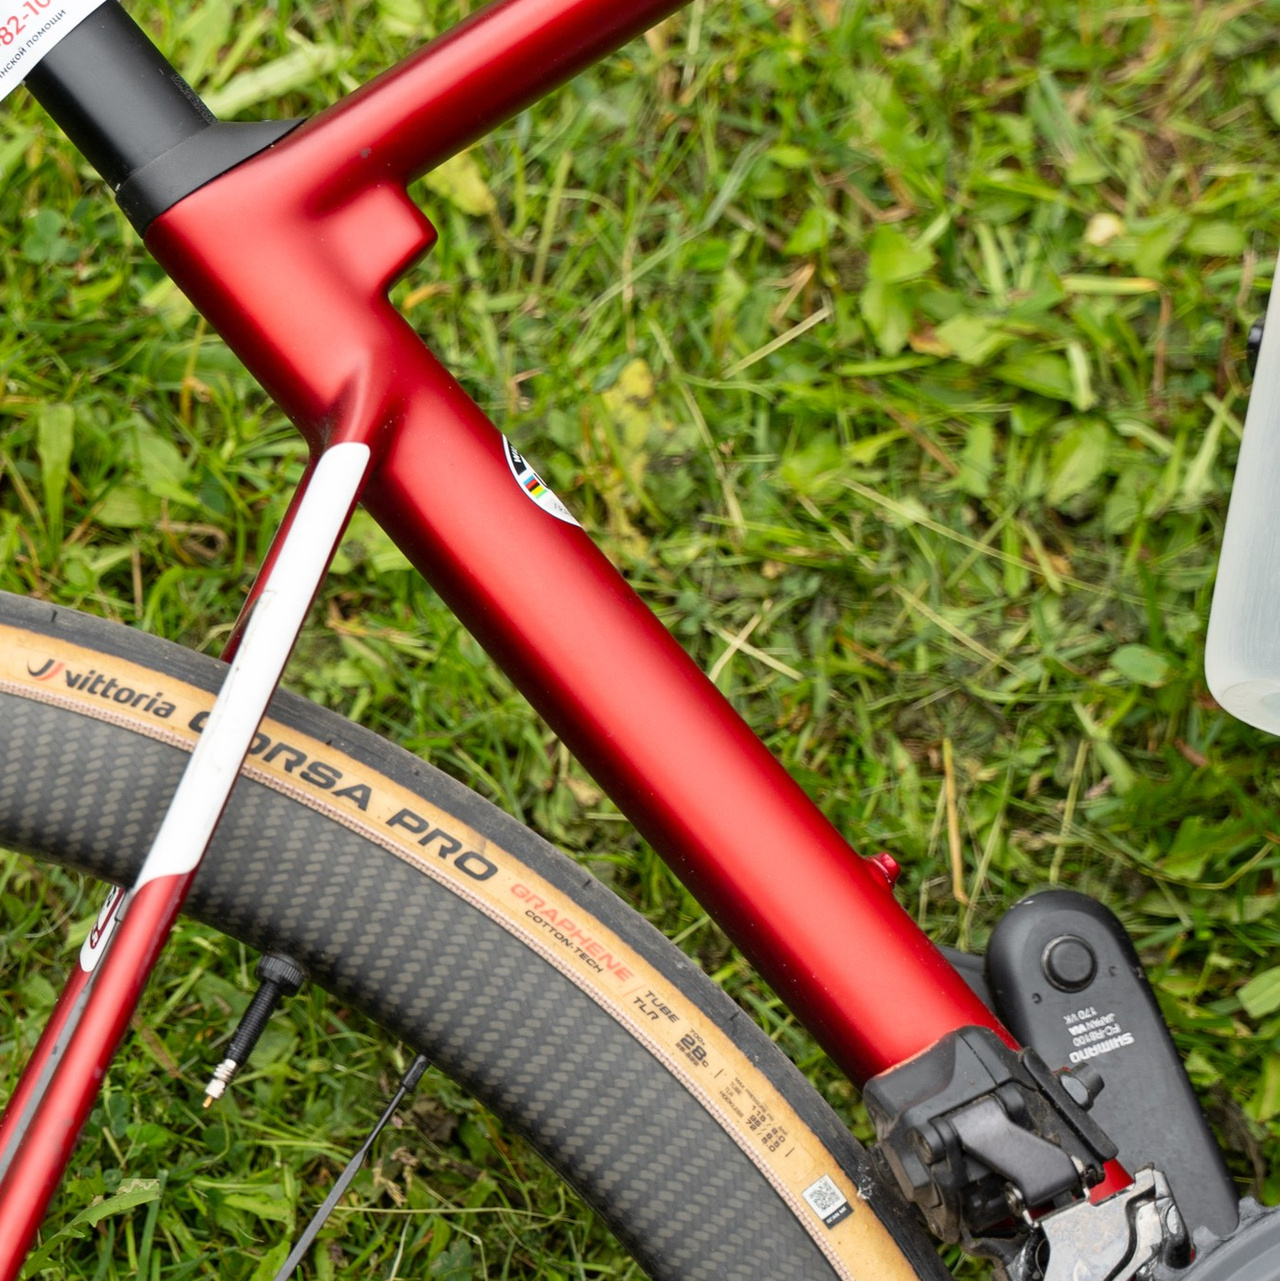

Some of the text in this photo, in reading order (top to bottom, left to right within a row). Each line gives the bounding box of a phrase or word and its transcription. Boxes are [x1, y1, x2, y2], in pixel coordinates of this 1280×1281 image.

[25, 8, 68, 49] помощи
[64, 667, 176, 720] vittoria
[385, 807, 499, 882] PRO
[509, 882, 635, 983] GRAPHENE
[632, 995, 660, 1022] TLR
[644, 989, 681, 1024] TUBE
[1068, 1031, 1136, 1064] SHIMANO
